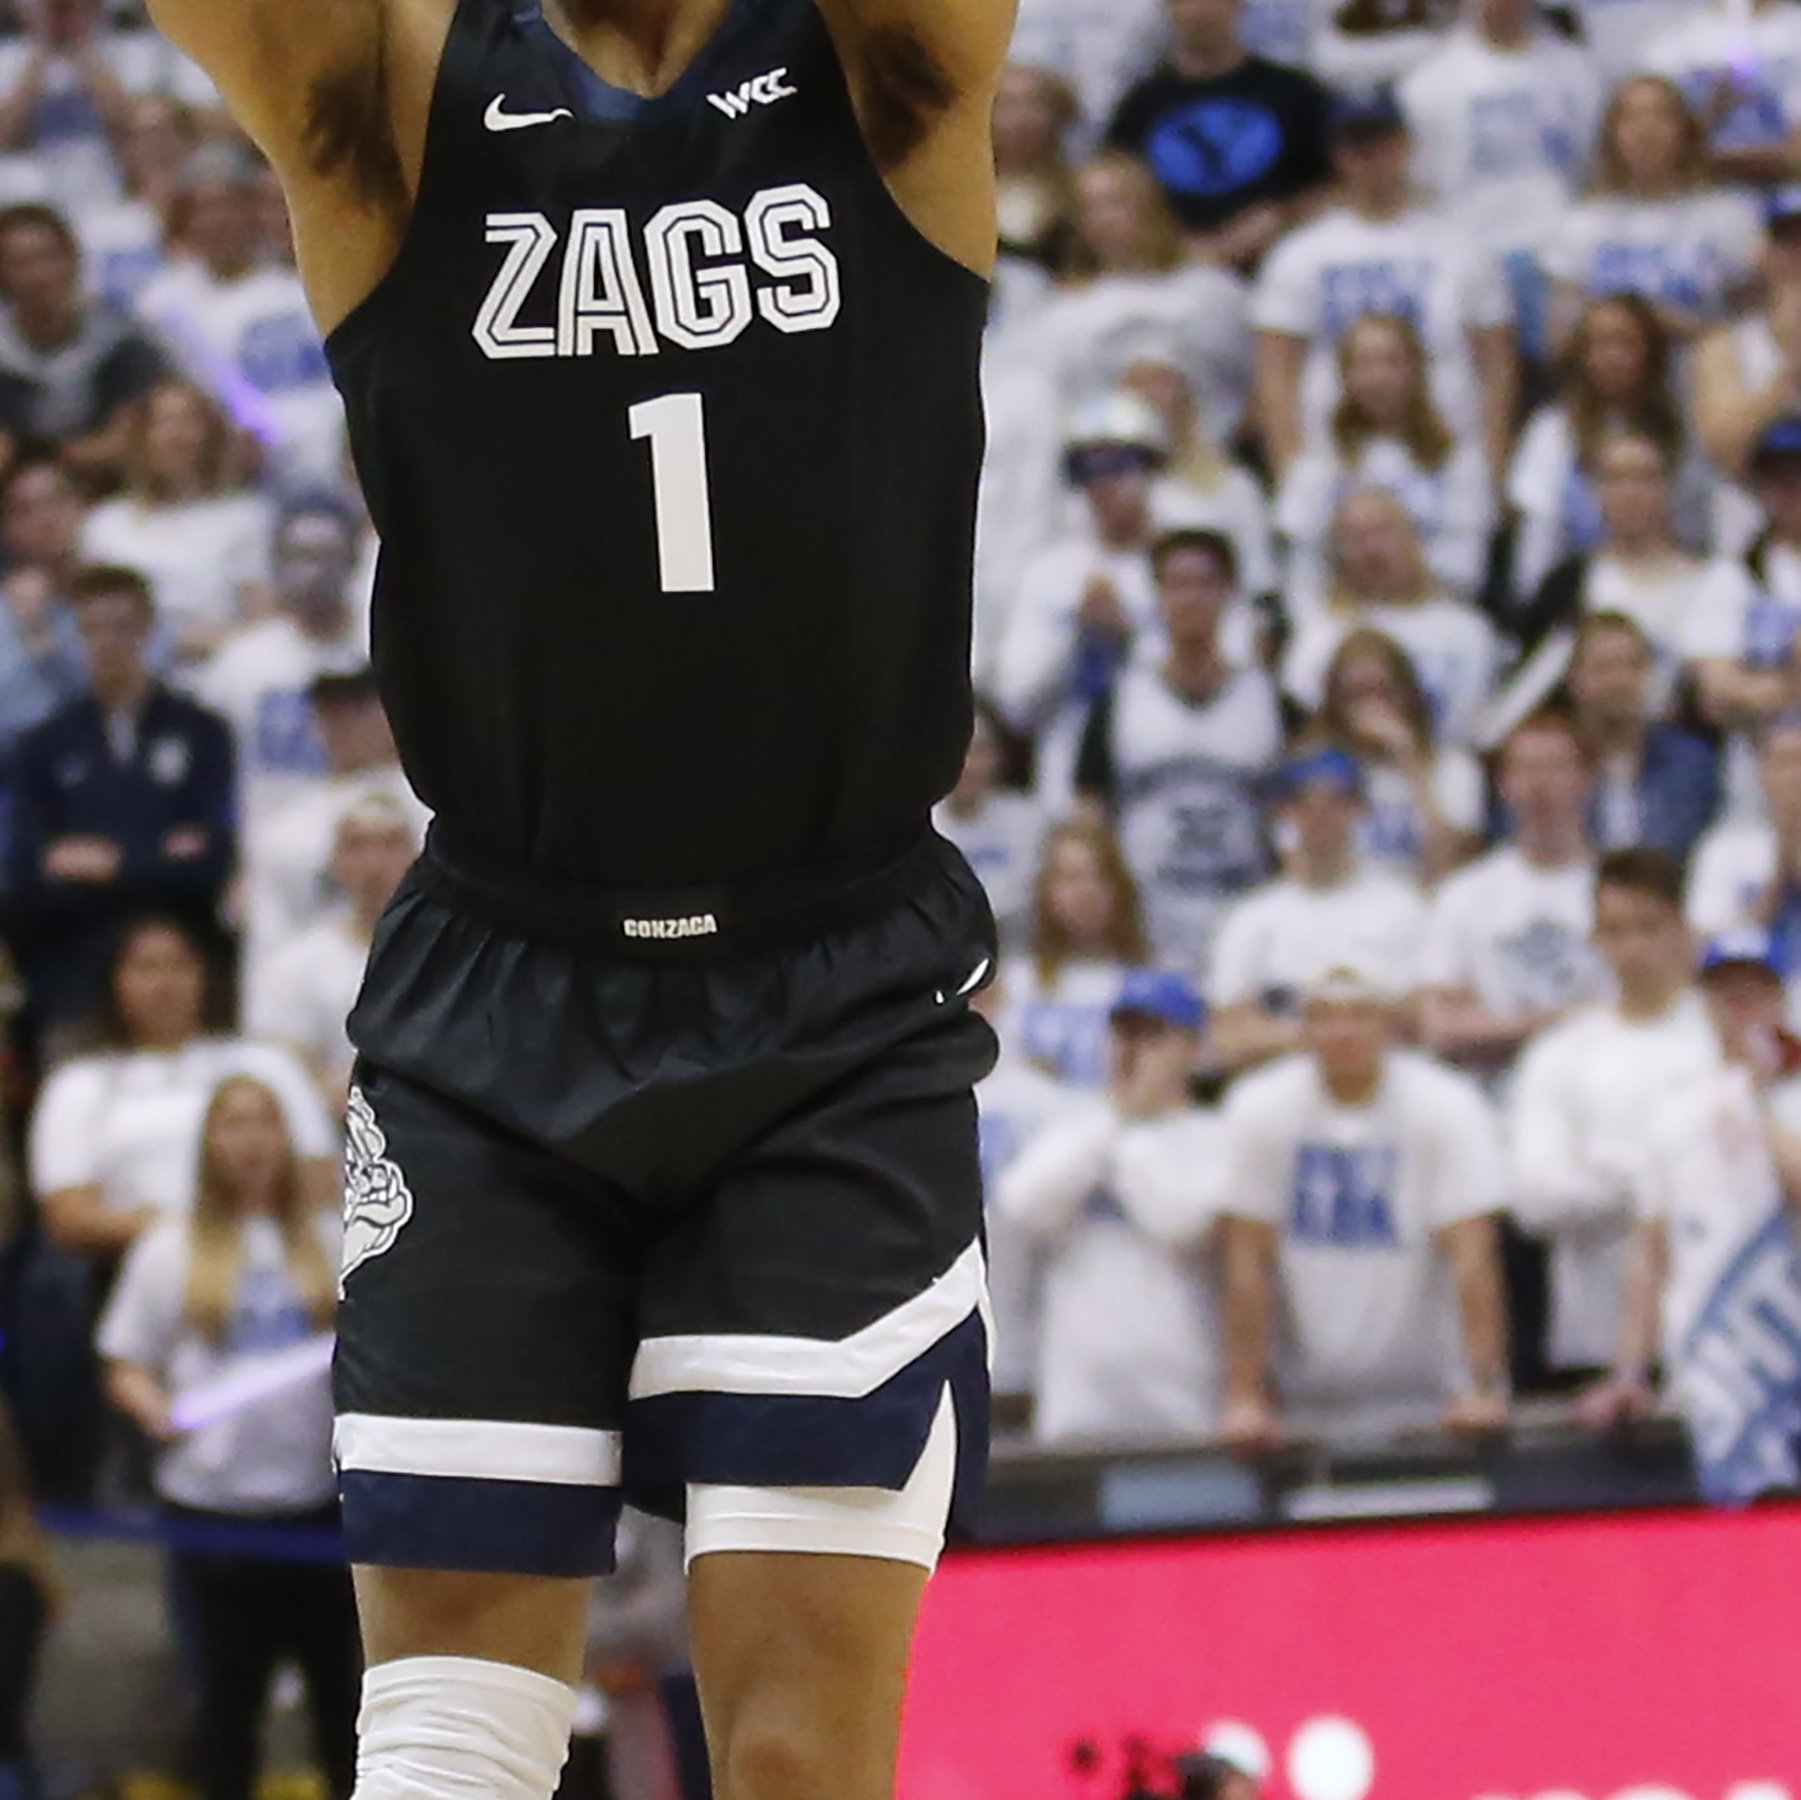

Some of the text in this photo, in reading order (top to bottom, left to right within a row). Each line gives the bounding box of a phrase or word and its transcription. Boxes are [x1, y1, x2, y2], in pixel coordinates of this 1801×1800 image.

[706, 67, 797, 119] WCC
[472, 183, 840, 359] ZAGS
[628, 393, 714, 592] 1
[623, 913, 717, 939] GONZAGA
